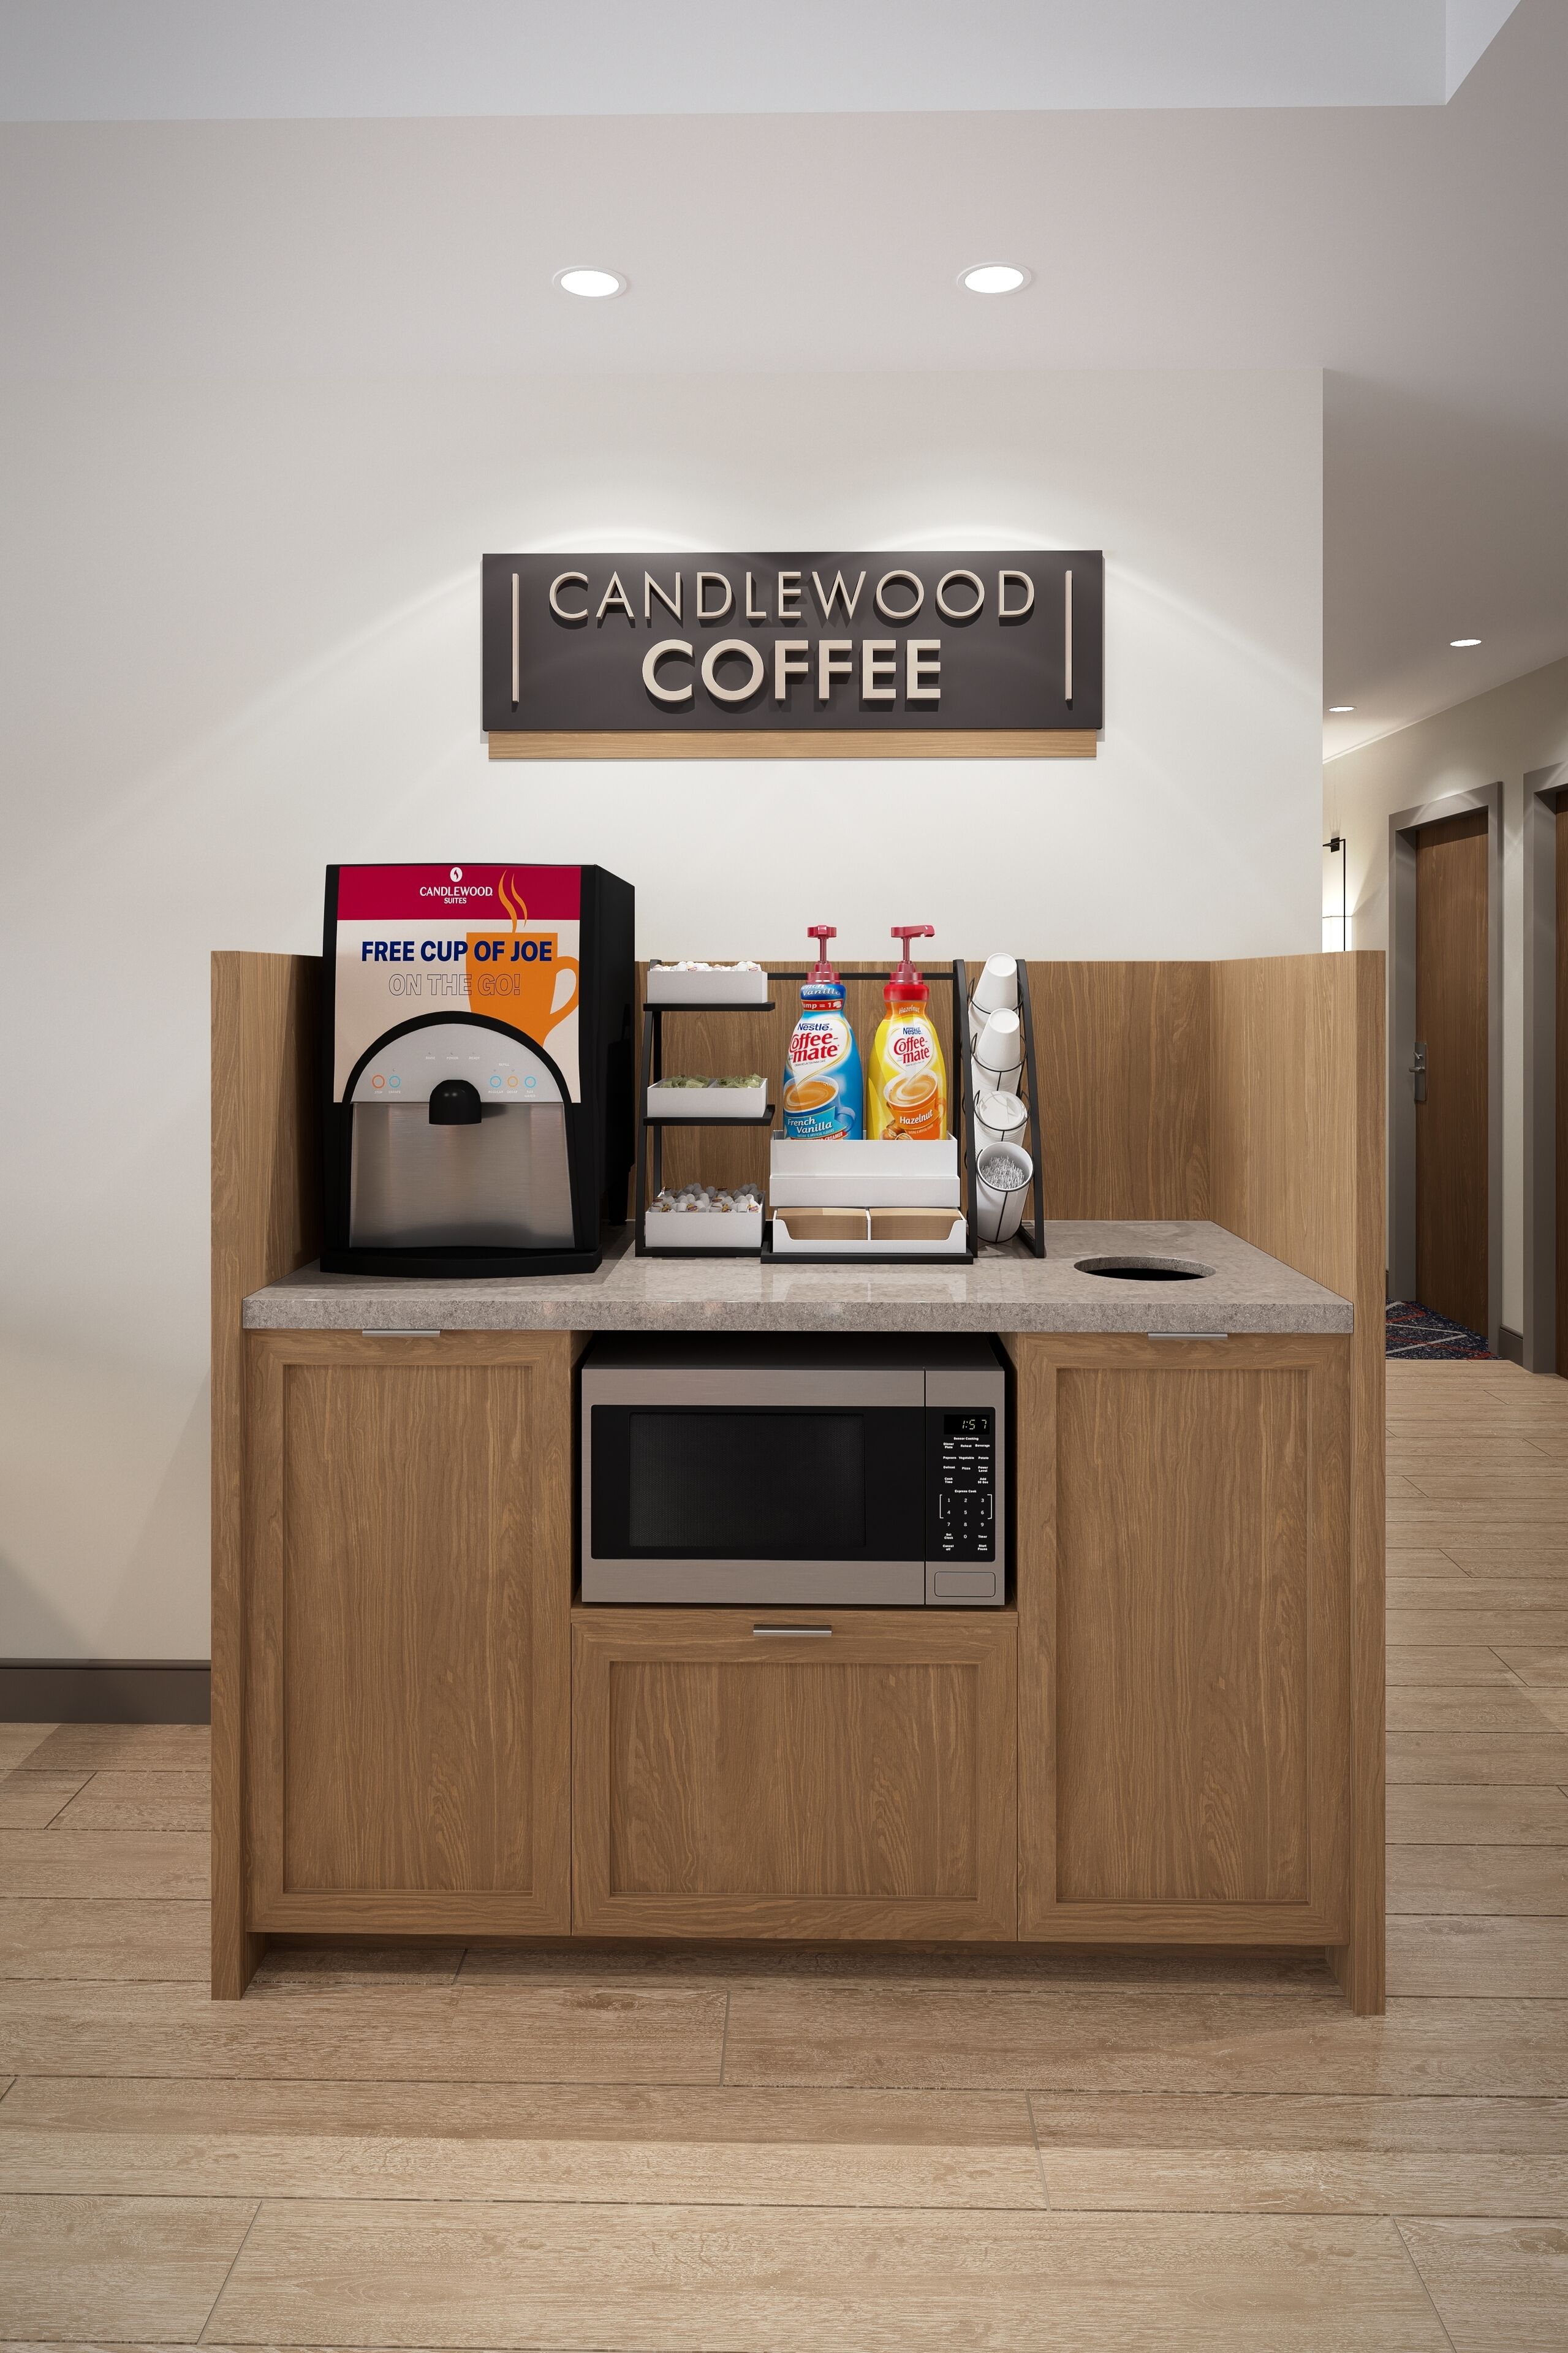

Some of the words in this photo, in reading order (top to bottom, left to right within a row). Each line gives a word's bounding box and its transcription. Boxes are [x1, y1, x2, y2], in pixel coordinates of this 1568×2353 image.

[548, 569, 1035, 621] CANDLEWOOD
[642, 638, 942, 703] COFFEE
[419, 886, 493, 897] CANDLEWOOD
[361, 941, 415, 962] FREE
[420, 941, 468, 962] CUP
[474, 941, 505, 962] OF
[510, 941, 552, 962] JOE
[388, 973, 422, 996] ON
[427, 973, 472, 996] THE
[477, 973, 521, 996] GO!
[899, 1005, 920, 1015] Hazelnut
[793, 1045, 838, 1063] mate
[903, 1047, 930, 1064] mate
[788, 1117, 816, 1126] French
[900, 1108, 933, 1124] Hazelnut
[797, 1121, 833, 1134] Vanilla
[962, 1419, 987, 1430] 1:57
